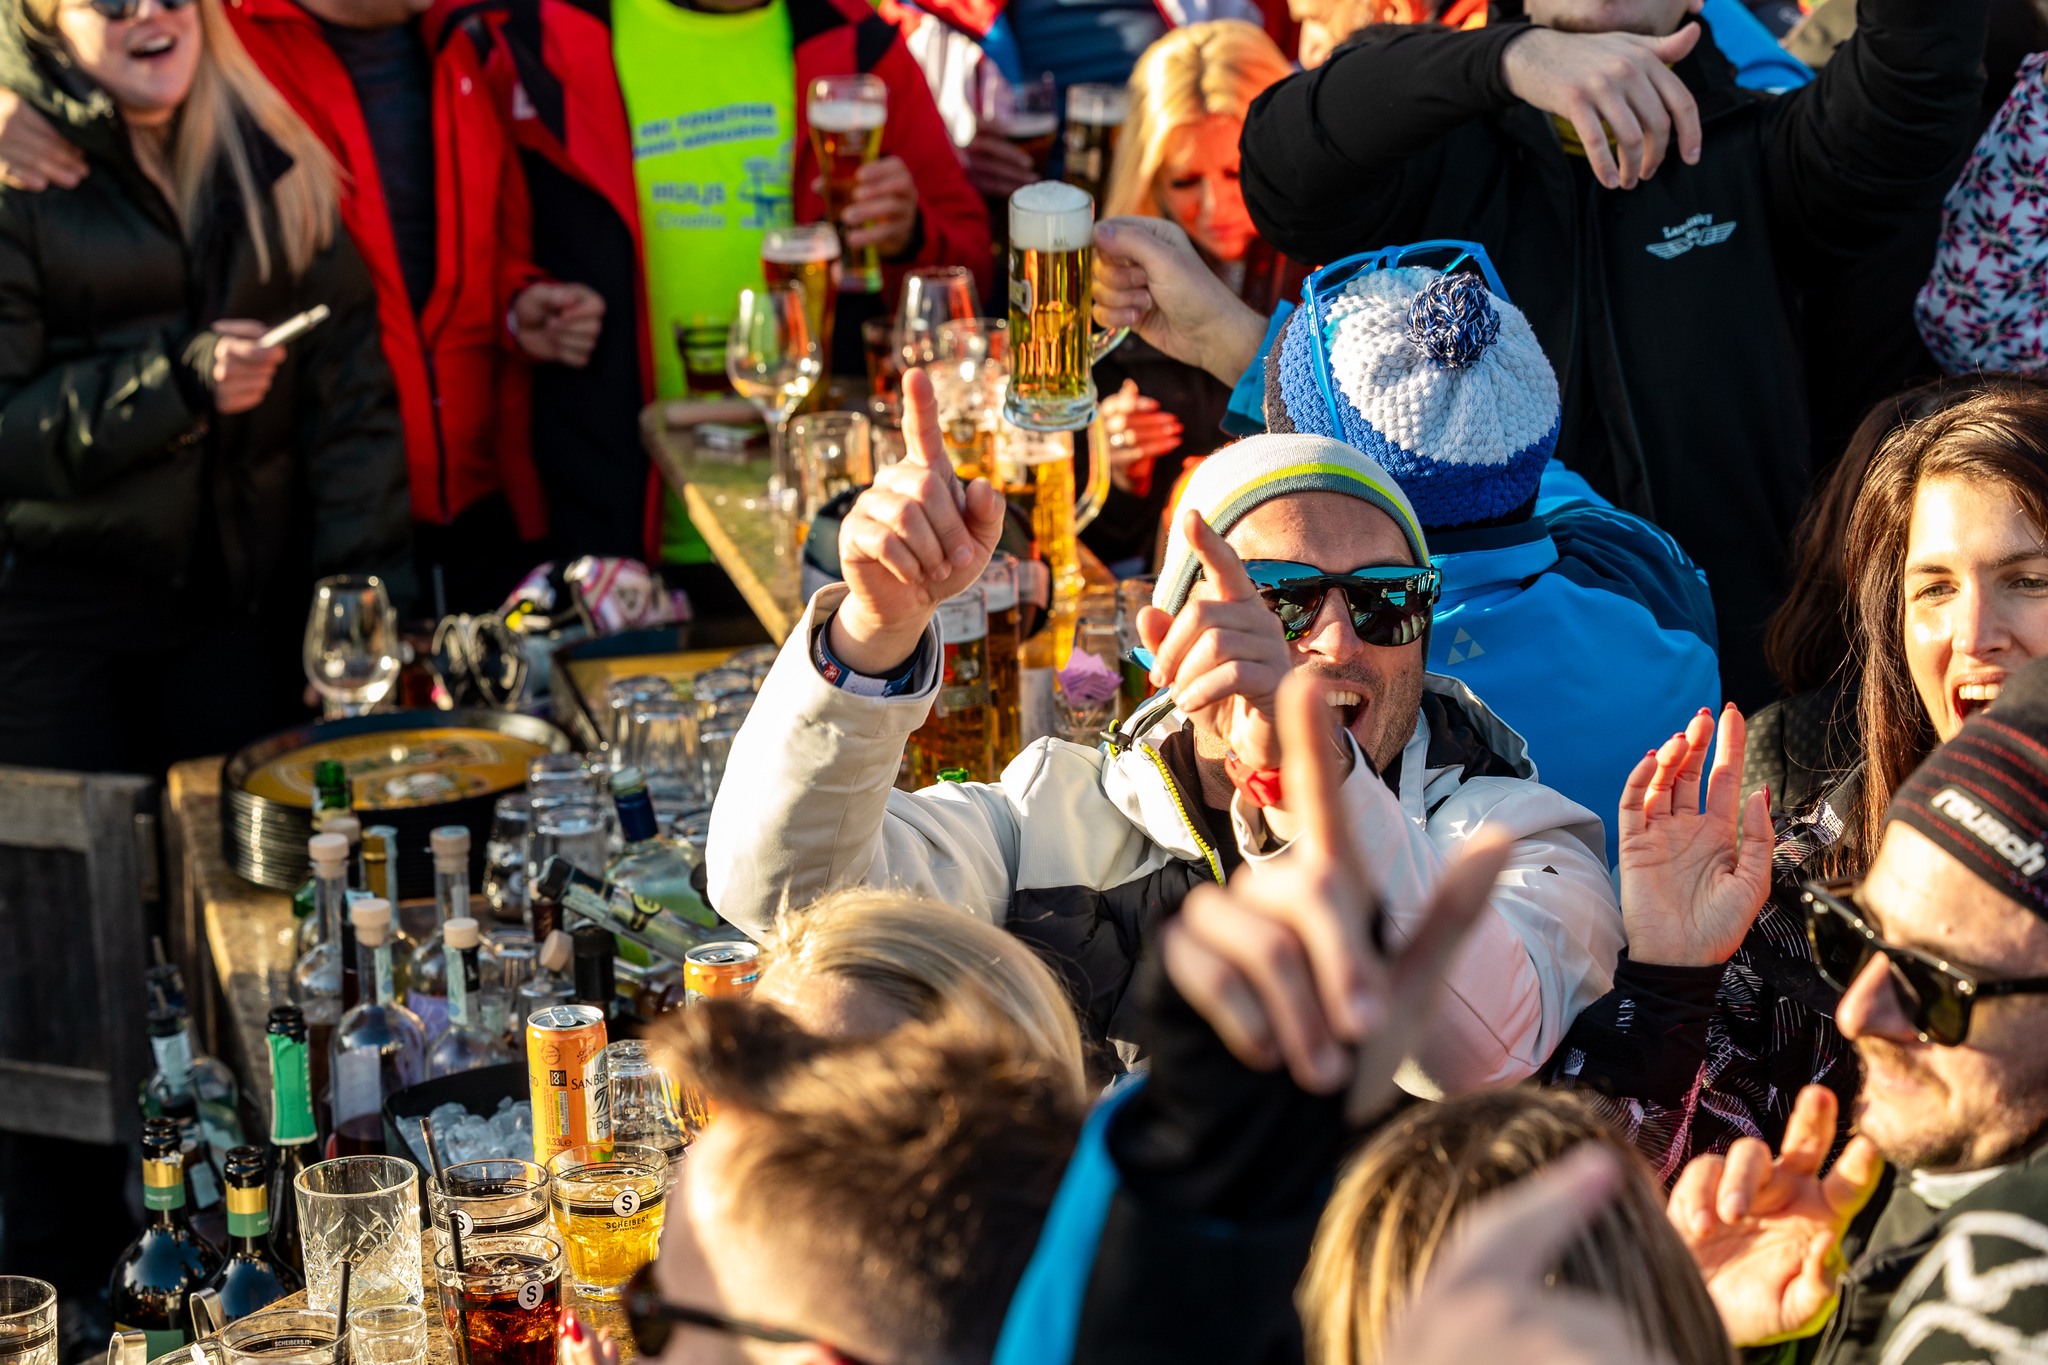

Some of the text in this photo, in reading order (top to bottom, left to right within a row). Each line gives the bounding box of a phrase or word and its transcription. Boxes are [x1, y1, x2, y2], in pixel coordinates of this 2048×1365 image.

[1930, 787, 2047, 877] reusch
[621, 1194, 633, 1213] S
[526, 1284, 537, 1304] S
